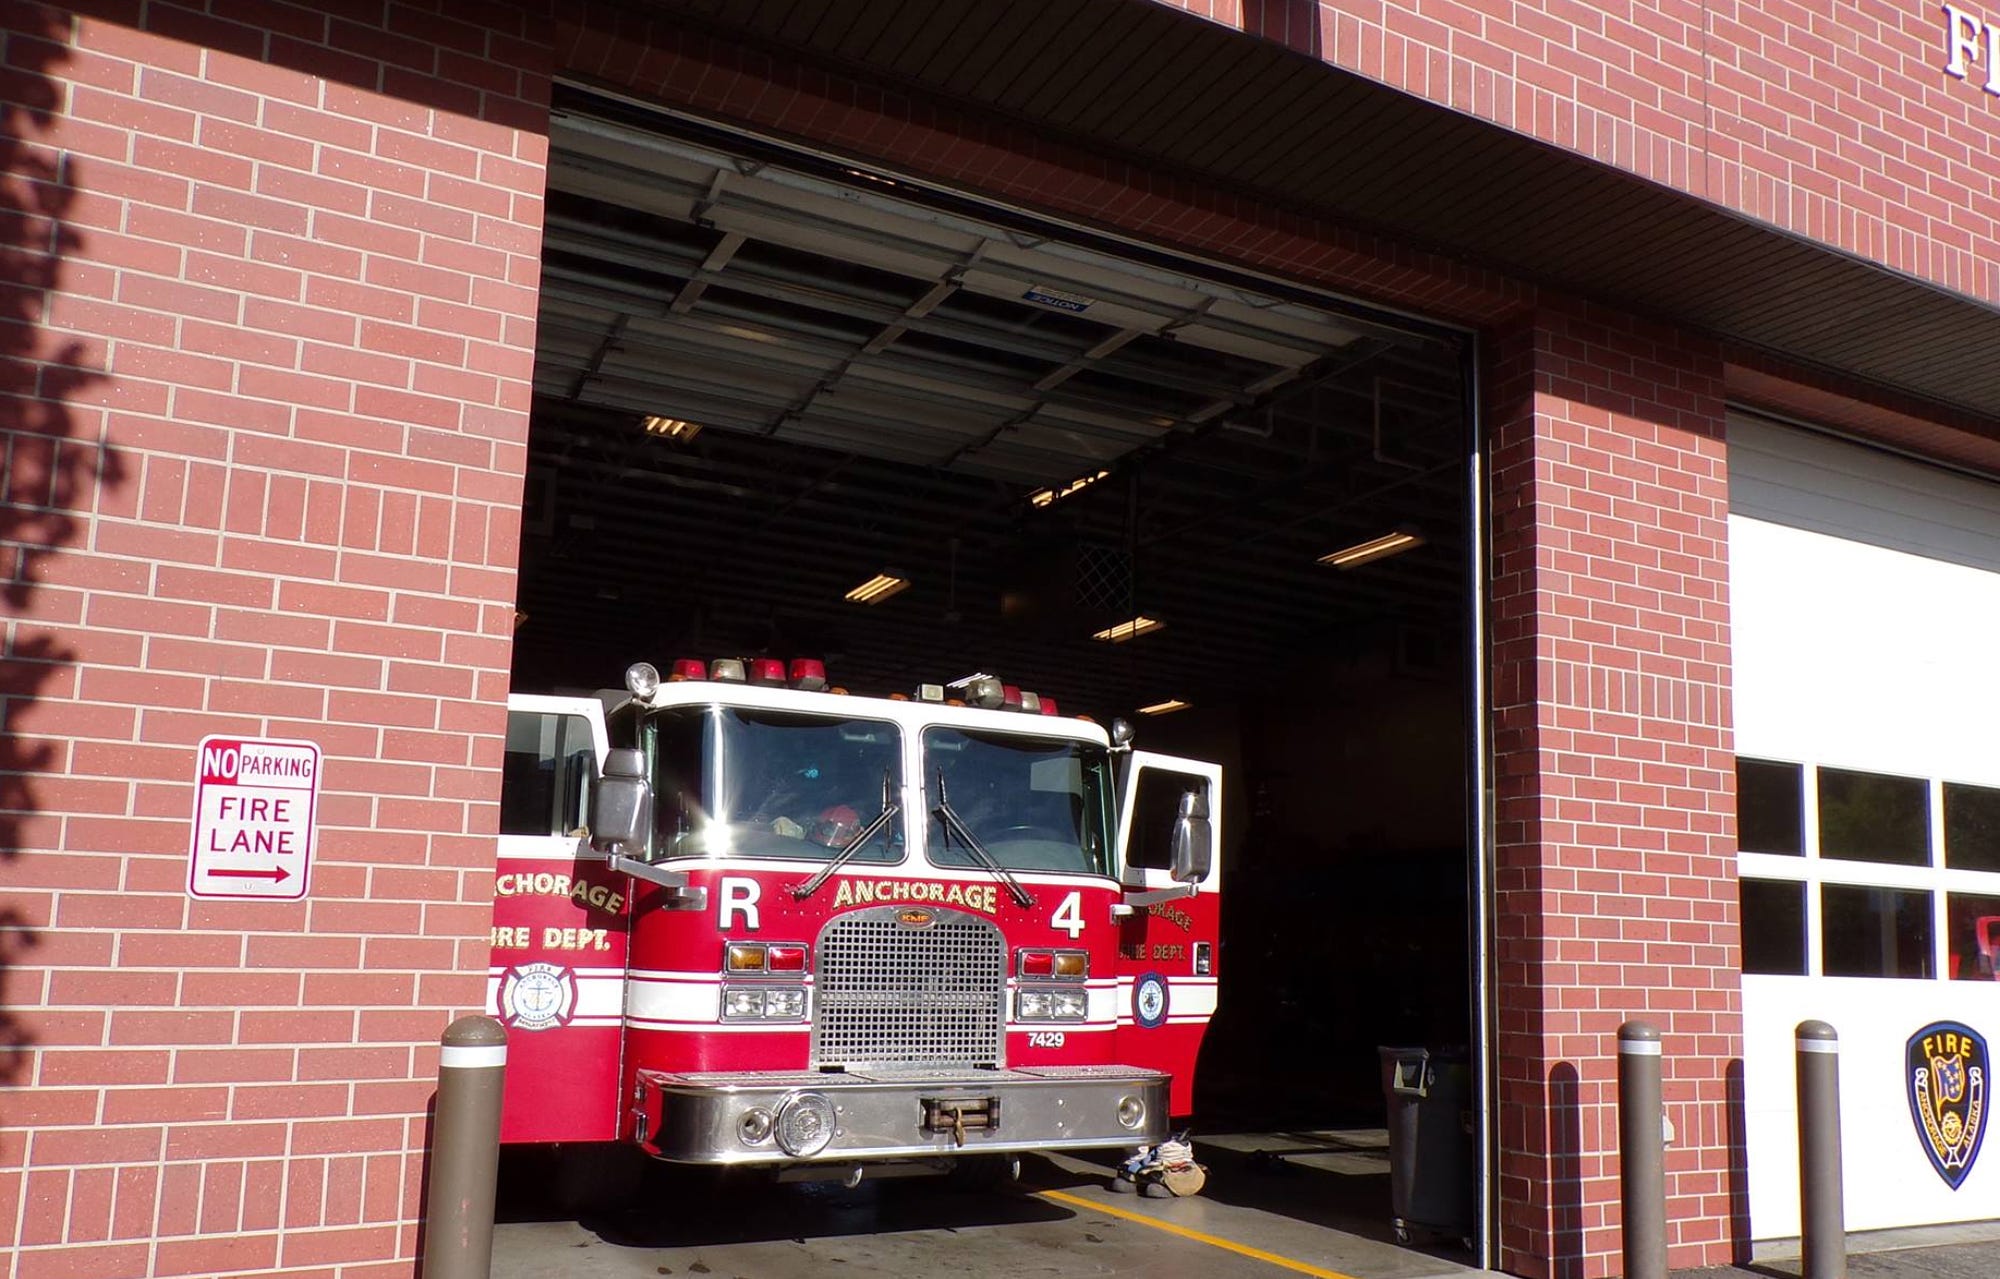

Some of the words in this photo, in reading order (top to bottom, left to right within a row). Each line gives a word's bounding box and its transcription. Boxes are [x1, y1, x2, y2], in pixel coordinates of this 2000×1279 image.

[203, 747, 239, 779] NO
[241, 755, 312, 778] PARKING
[219, 796, 290, 822] FIRE
[210, 828, 294, 854] LANE
[494, 872, 625, 915] CHORAGE
[717, 876, 761, 931] R
[832, 878, 997, 915] ANCHORAGE
[1050, 891, 1086, 939] 4
[543, 928, 611, 951] DEPT.
[1027, 1032, 1065, 1047] 7429
[1922, 1033, 1973, 1058] FIRE
